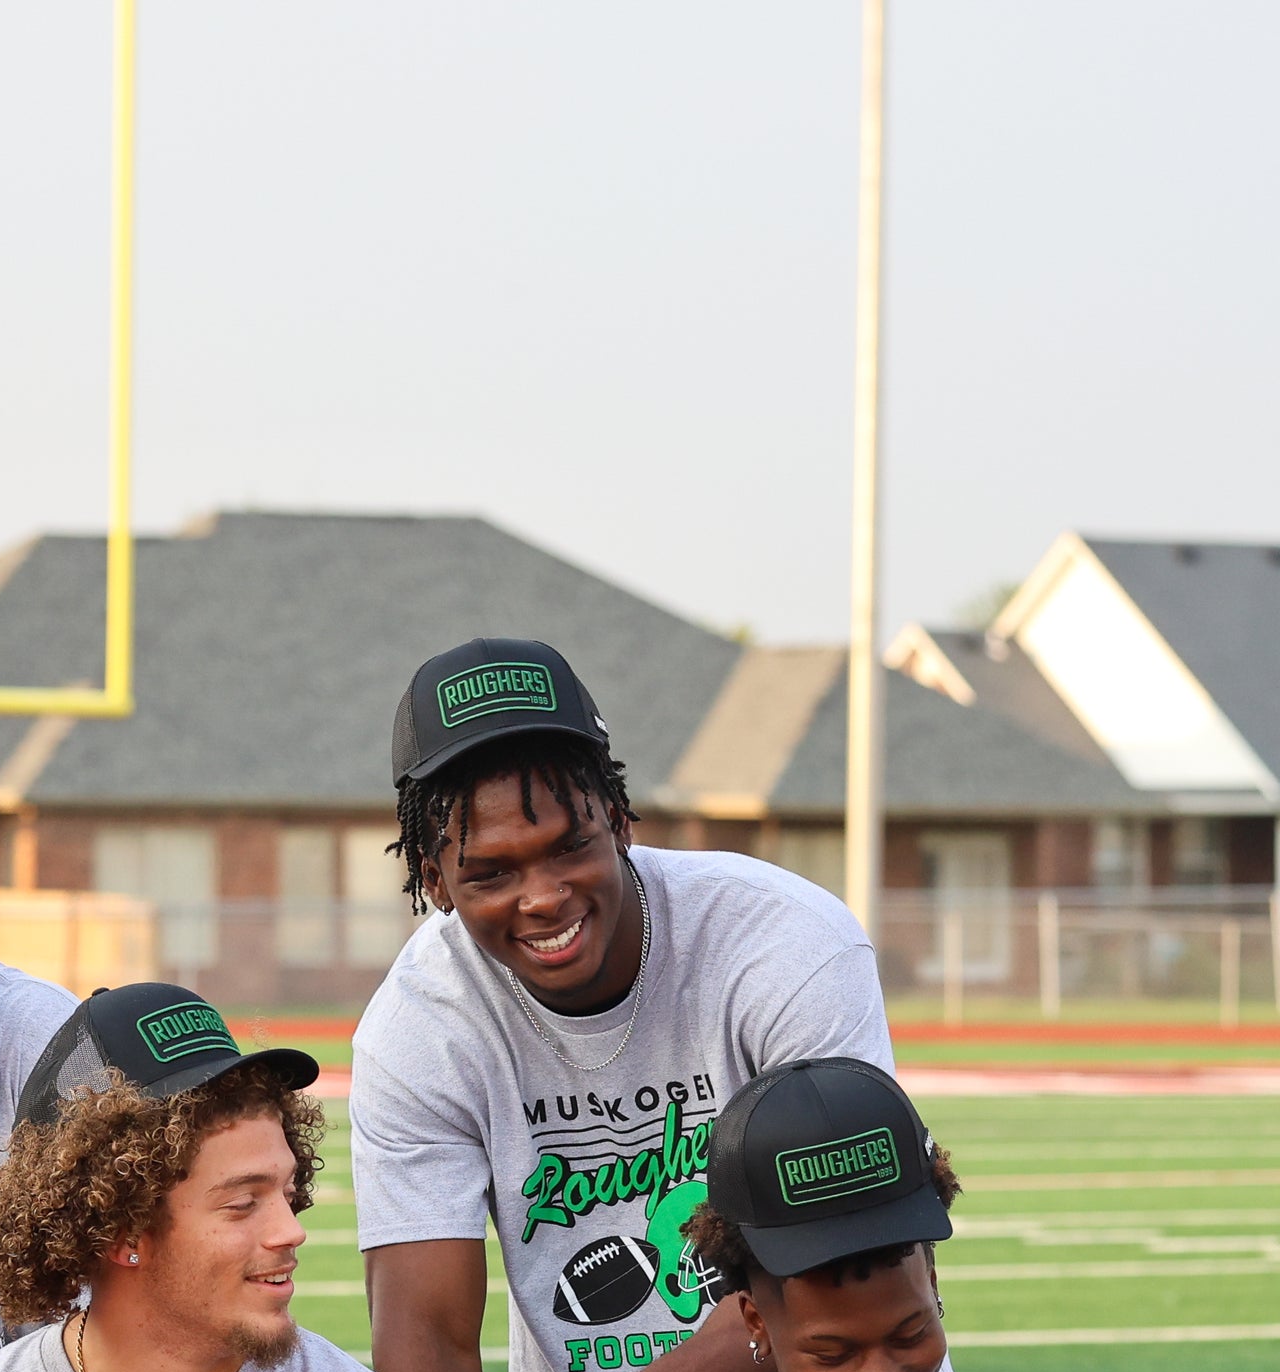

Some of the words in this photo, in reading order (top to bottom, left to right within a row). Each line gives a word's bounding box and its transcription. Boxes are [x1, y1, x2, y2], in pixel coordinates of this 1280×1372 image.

[444, 669, 547, 709] ROUGHERS
[521, 1101, 716, 1243] Roughe
[785, 1138, 892, 1186] ROUGHERS
